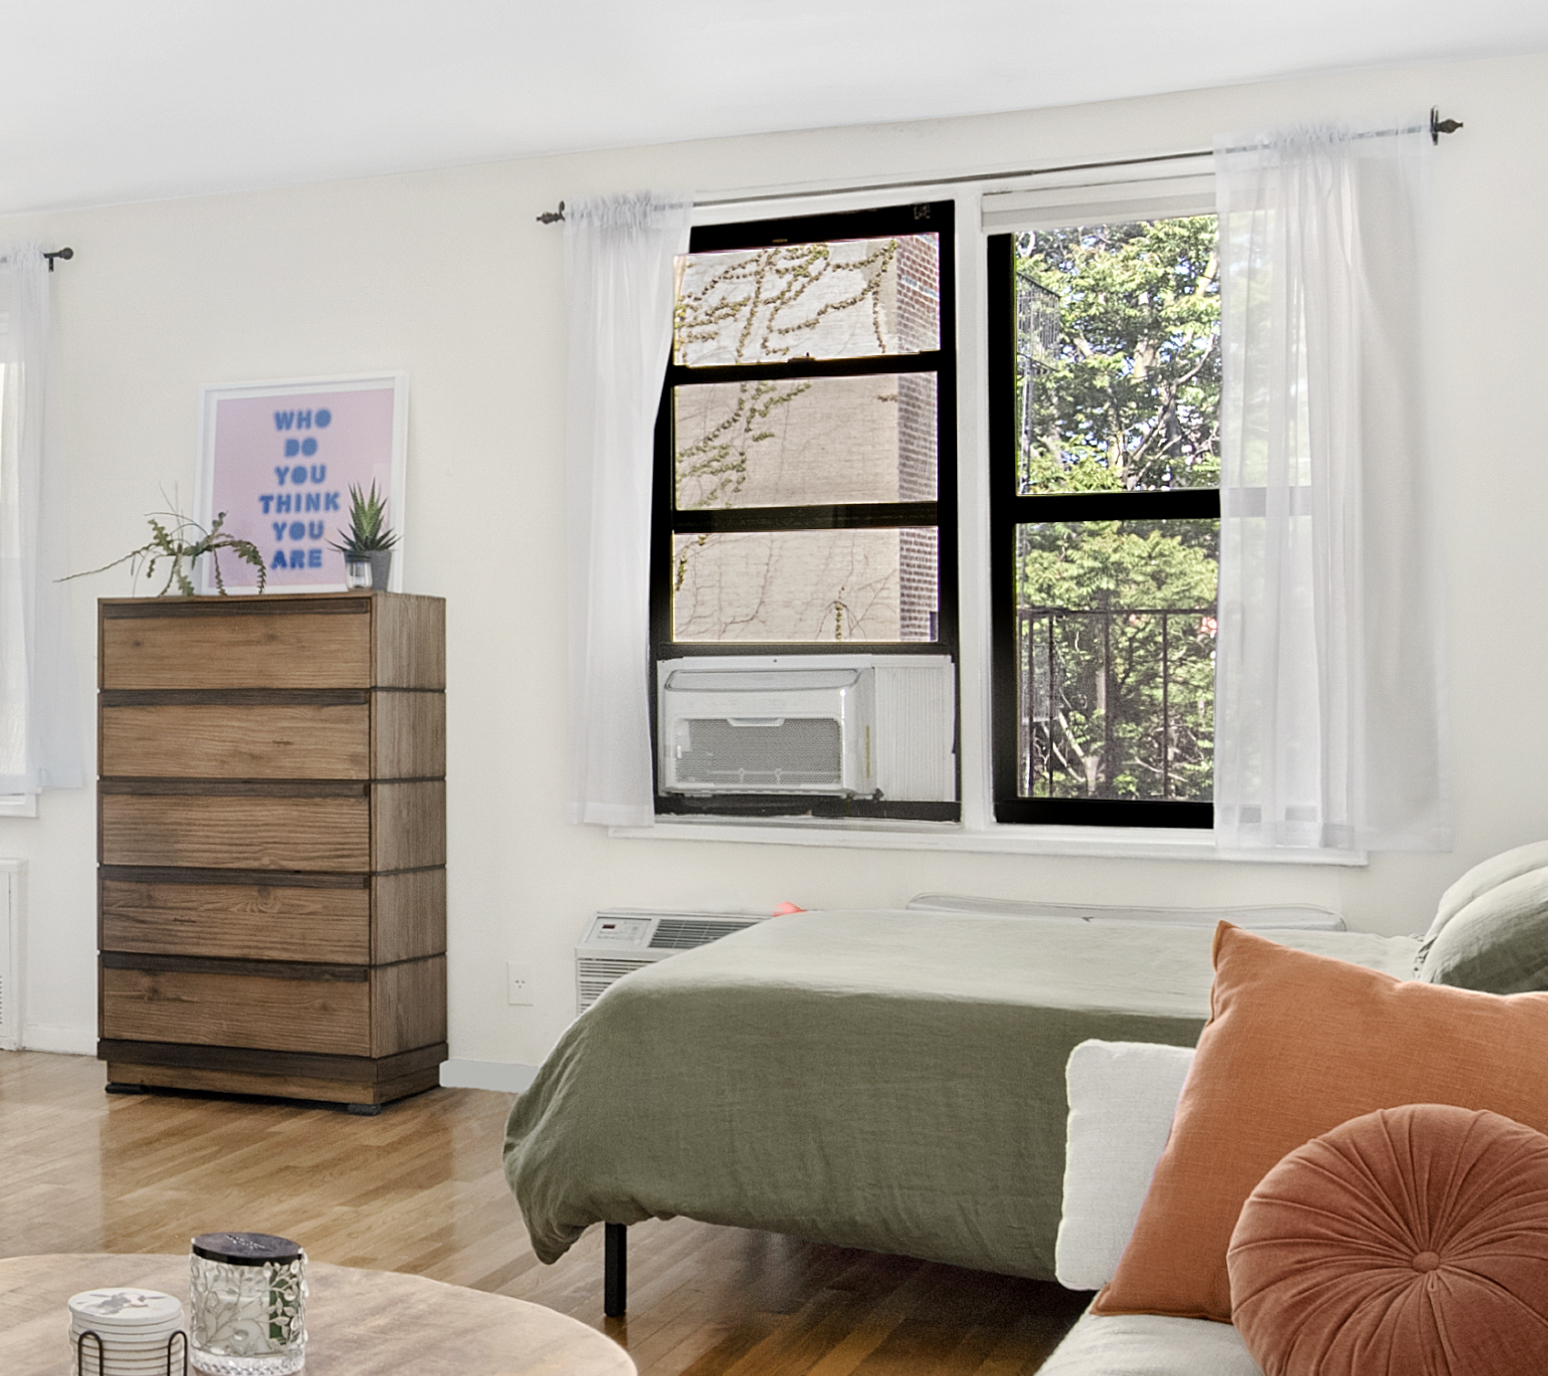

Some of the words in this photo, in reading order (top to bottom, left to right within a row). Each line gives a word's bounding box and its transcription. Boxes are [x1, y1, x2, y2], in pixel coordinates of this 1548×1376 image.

[274, 409, 331, 431] WHO
[284, 437, 318, 457] DO
[275, 464, 326, 486] YOU
[259, 491, 340, 514] THINK
[272, 520, 324, 542] YOU
[271, 548, 323, 569] ARE
